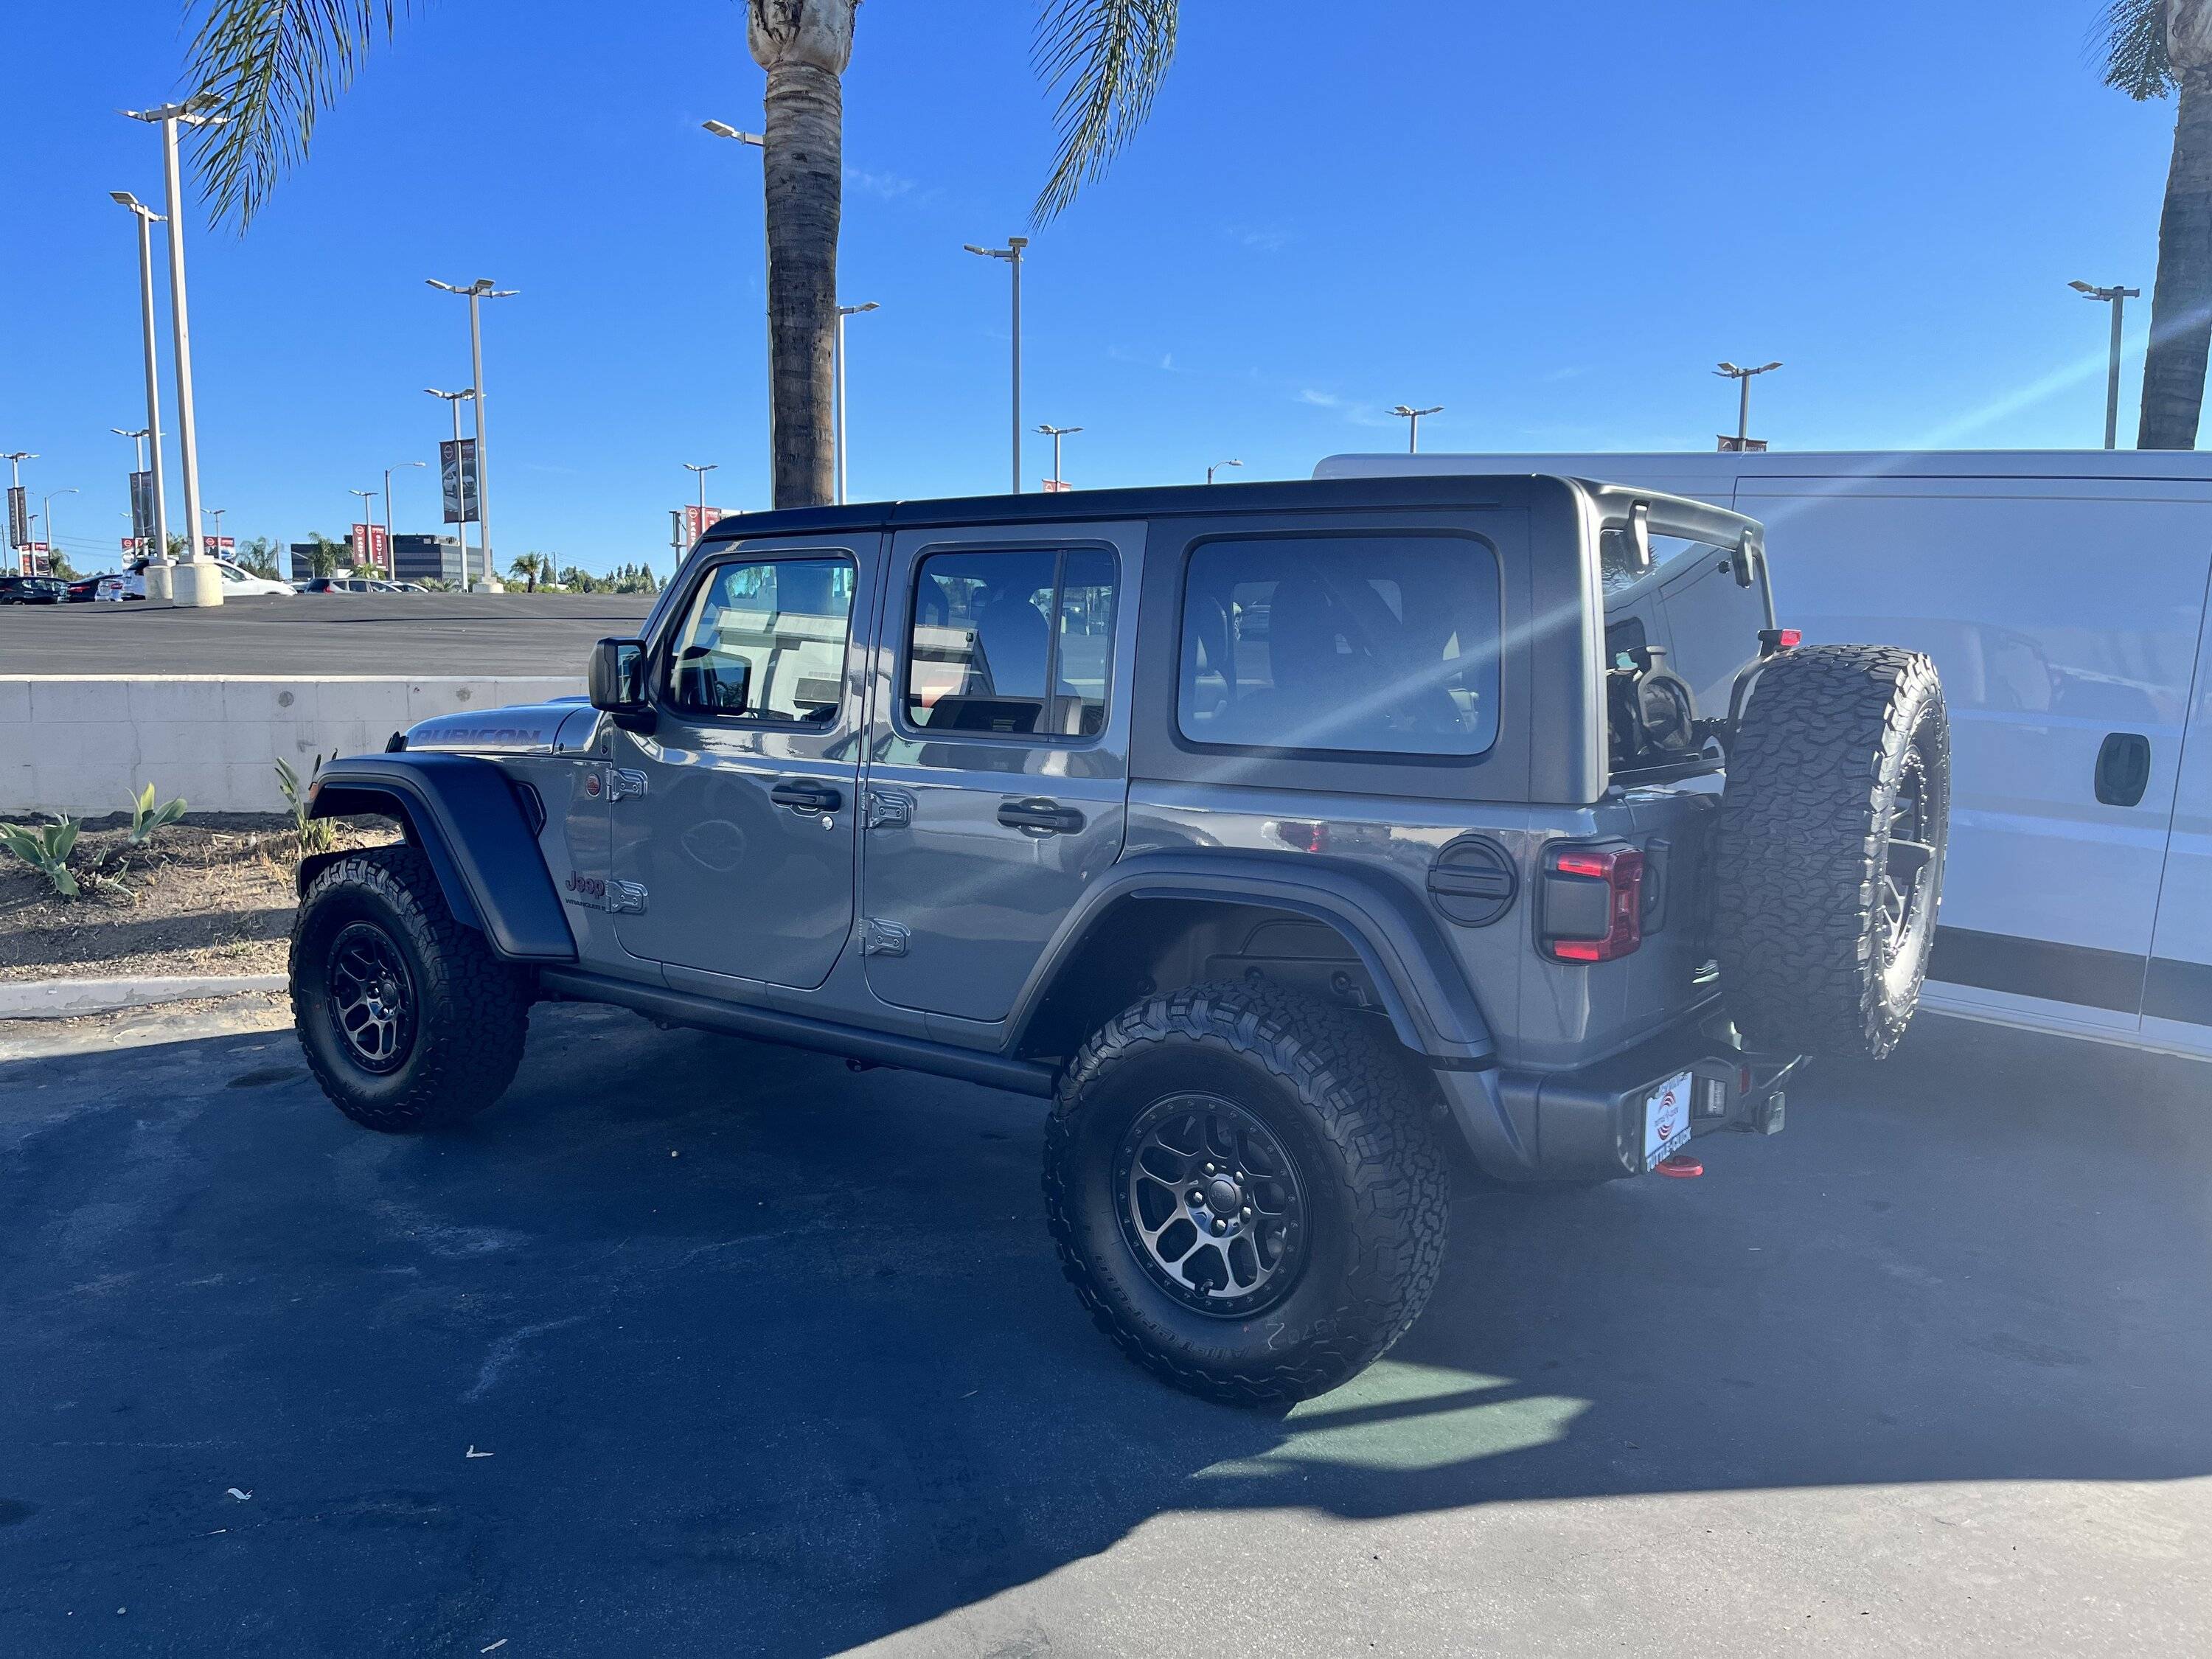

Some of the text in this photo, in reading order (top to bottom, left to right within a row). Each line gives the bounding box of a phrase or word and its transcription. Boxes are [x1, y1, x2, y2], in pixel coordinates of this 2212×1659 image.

[414, 729, 542, 745] RUBICON
[565, 870, 605, 900] Jeep
[565, 898, 601, 910] WRANGLER
